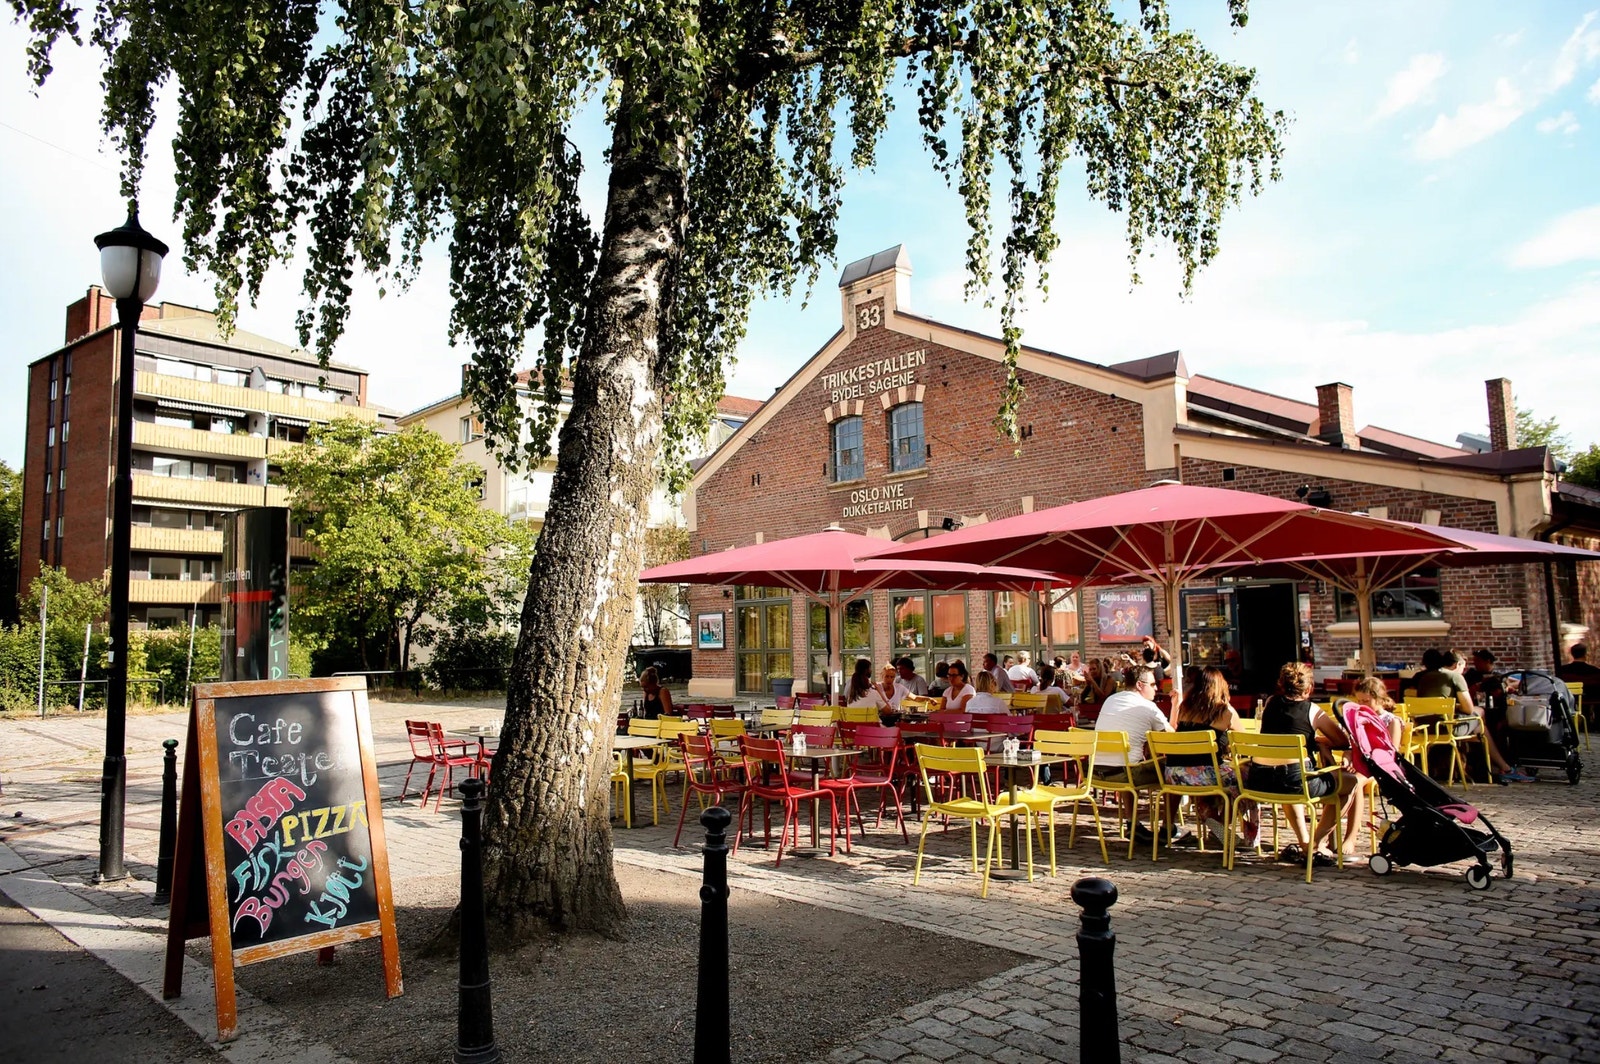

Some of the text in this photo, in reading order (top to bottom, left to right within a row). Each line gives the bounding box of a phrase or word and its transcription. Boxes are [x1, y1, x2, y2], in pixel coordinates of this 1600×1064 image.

[859, 304, 881, 330] 33
[821, 349, 926, 391] TRIKKESTALLEN
[832, 371, 915, 404] BYDEL SAGENE
[842, 497, 914, 518] DUKKETEATRET
[851, 484, 904, 504] OSLO NYE
[229, 713, 302, 745] Cafe
[224, 776, 307, 855] PASTA
[281, 800, 370, 848] PIZZA
[233, 840, 328, 939] Burger
